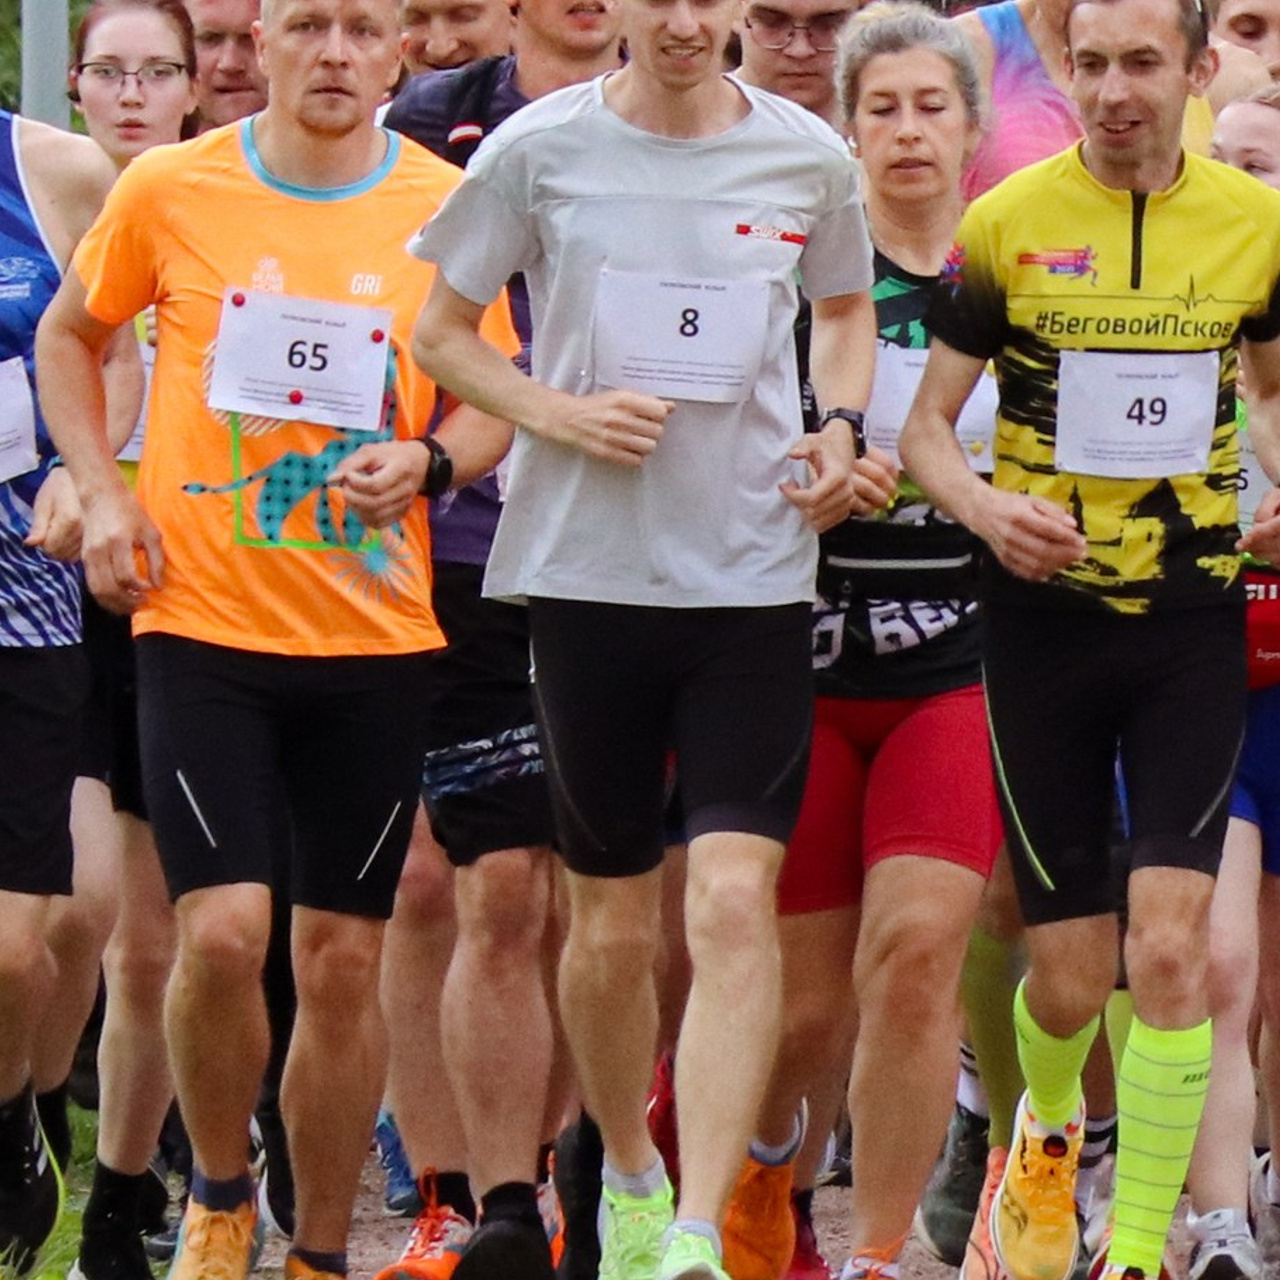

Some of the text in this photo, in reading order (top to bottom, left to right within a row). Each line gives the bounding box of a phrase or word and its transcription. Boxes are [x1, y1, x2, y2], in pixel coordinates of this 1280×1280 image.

[679, 307, 700, 338] 8
[1036, 310, 1234, 339] #БеговойПсков
[287, 340, 330, 372] 65
[1126, 397, 1168, 426] 49
